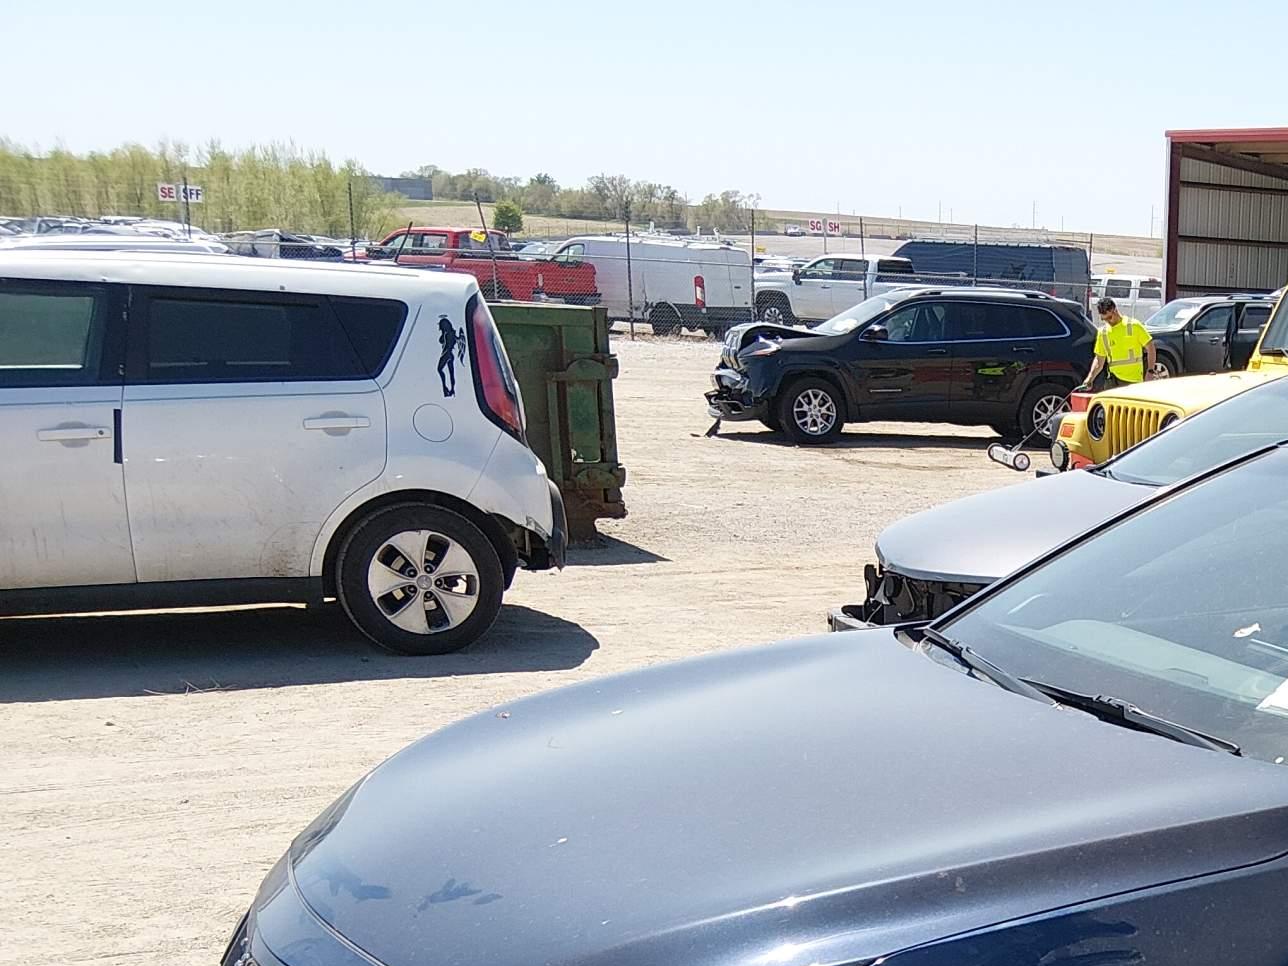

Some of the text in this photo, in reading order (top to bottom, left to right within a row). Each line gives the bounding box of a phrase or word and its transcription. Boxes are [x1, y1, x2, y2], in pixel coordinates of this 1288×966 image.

[160, 186, 175, 199] SE
[809, 220, 822, 231] SG
[828, 221, 840, 233] SH
